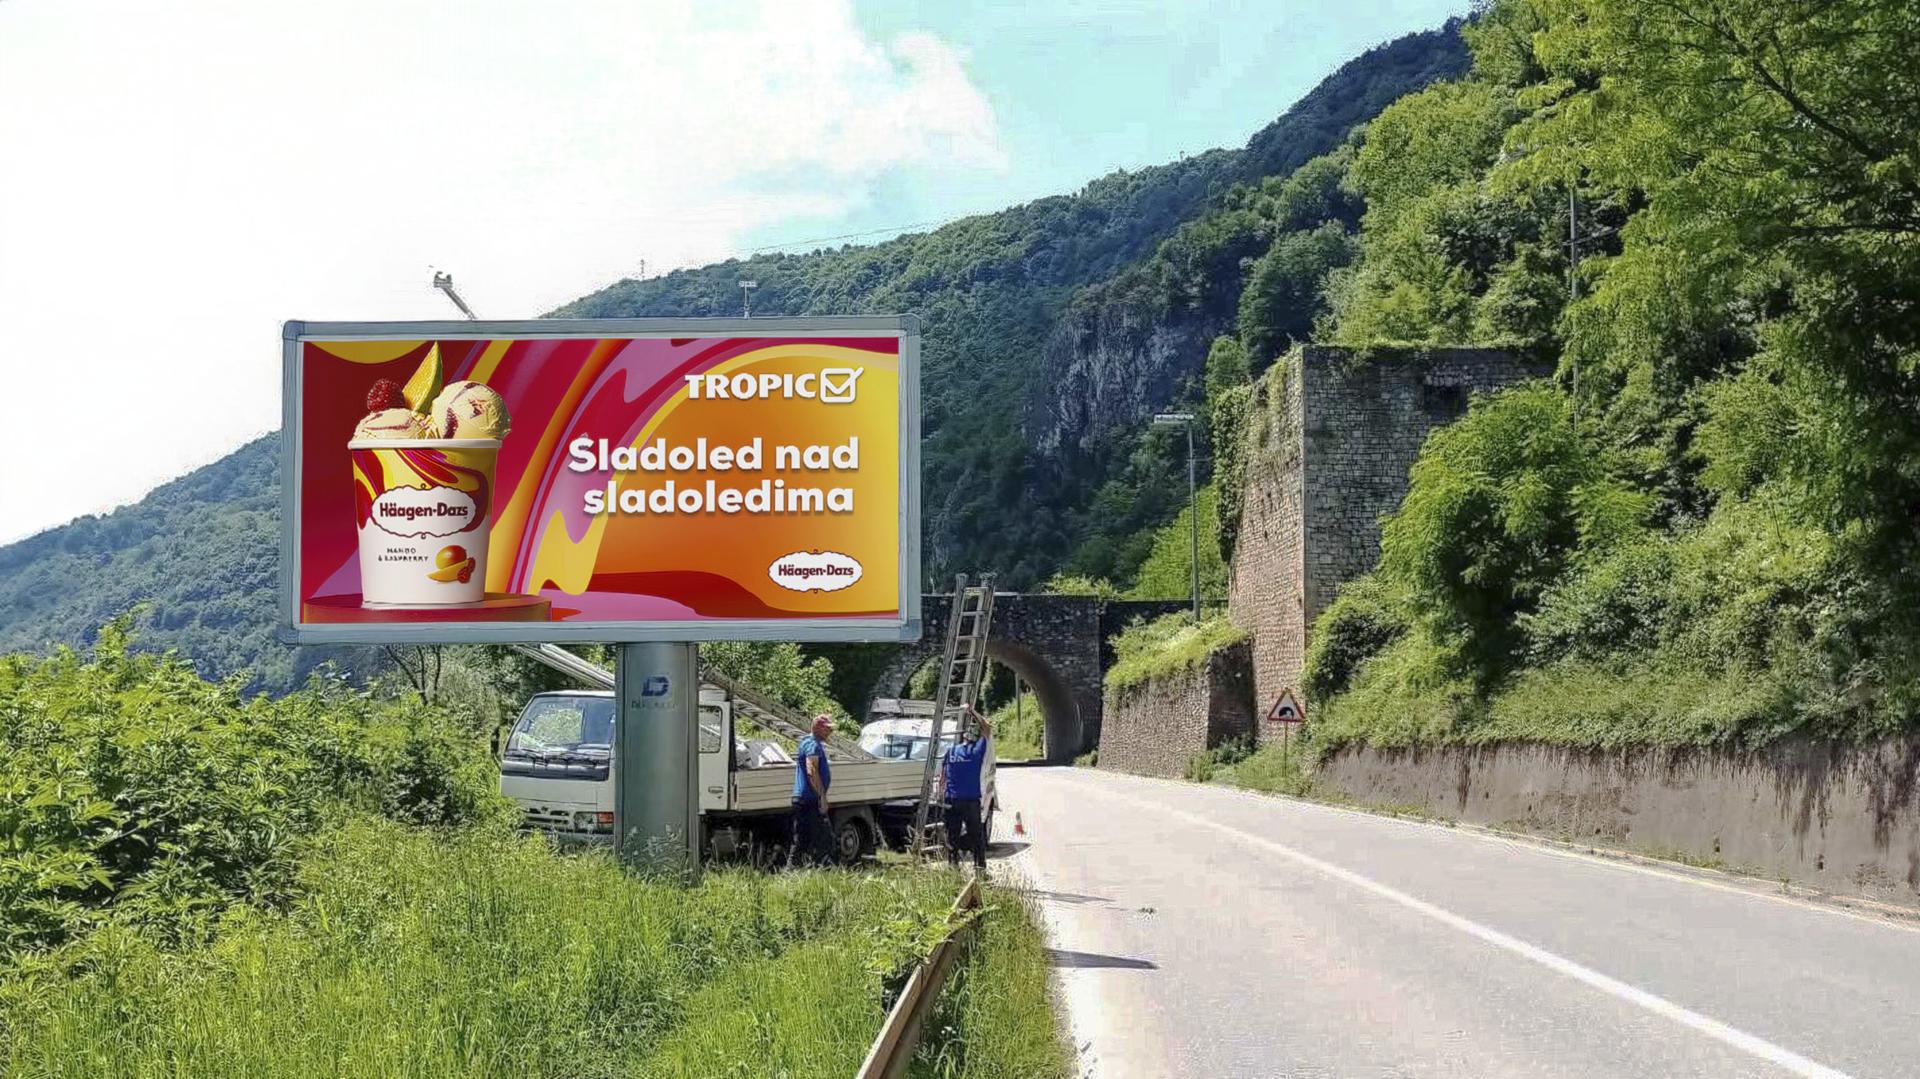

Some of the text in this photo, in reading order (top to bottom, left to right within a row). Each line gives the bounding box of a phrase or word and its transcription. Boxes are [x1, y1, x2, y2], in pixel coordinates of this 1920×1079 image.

[684, 372, 816, 400] TROPIC
[568, 436, 859, 473] Sladoled nad
[583, 479, 854, 515] sladoledima
[379, 502, 468, 521] Häagen-Dazs
[778, 564, 854, 579] Häagen-Dazs
